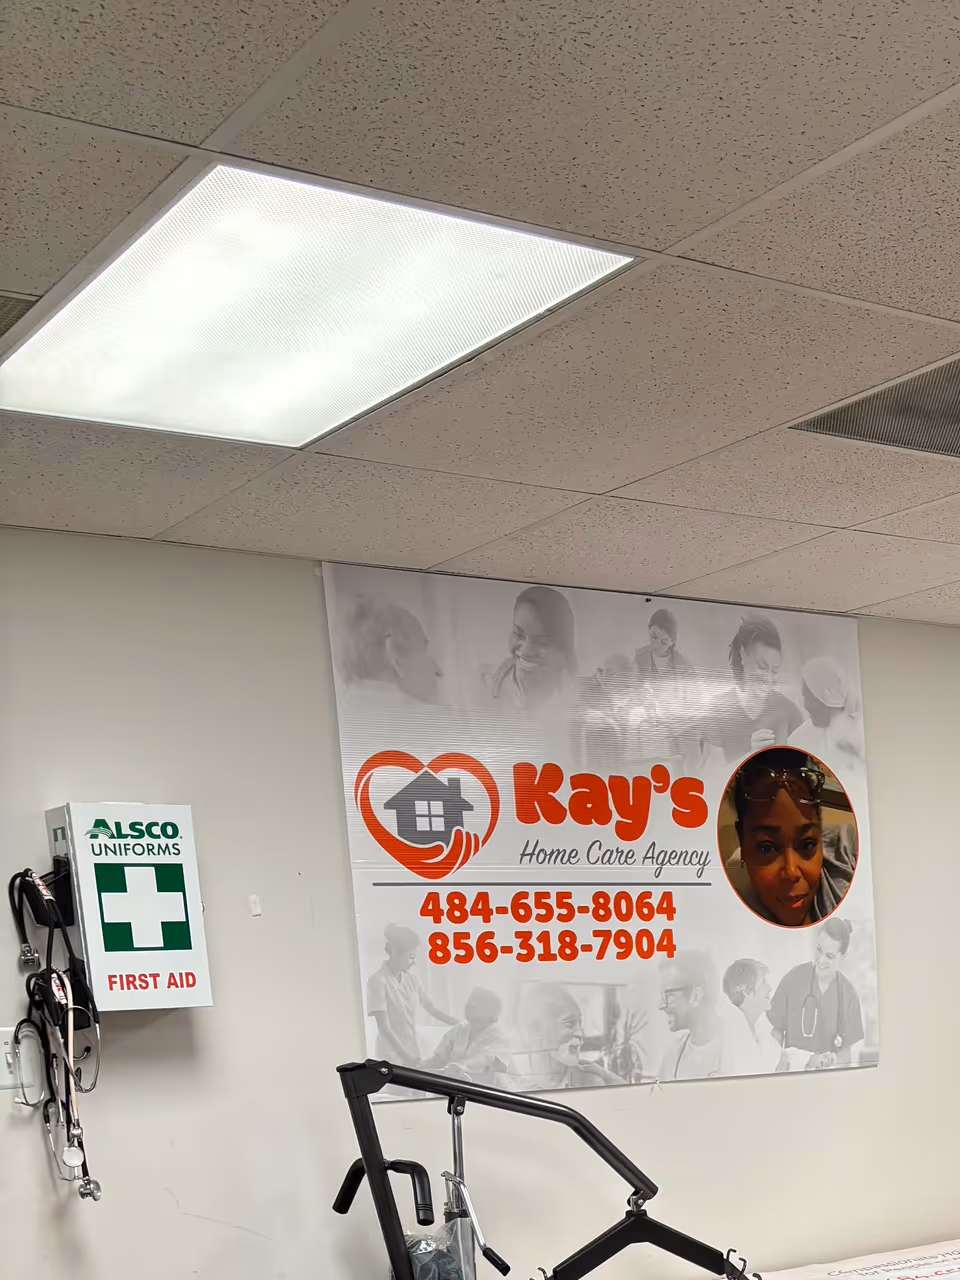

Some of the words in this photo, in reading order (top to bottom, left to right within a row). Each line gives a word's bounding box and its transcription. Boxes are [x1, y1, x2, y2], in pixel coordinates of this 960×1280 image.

[512, 762, 709, 842] Kay's
[86, 818, 180, 840] ALSCO
[90, 843, 181, 856] UNIFORMS
[519, 839, 580, 866] Home
[586, 839, 637, 866] Care
[642, 841, 711, 879] Agency
[419, 890, 677, 925] 484-655-8064
[428, 928, 677, 965] 856-318-7904
[107, 973, 160, 991] FIRST
[167, 971, 197, 989] AID
